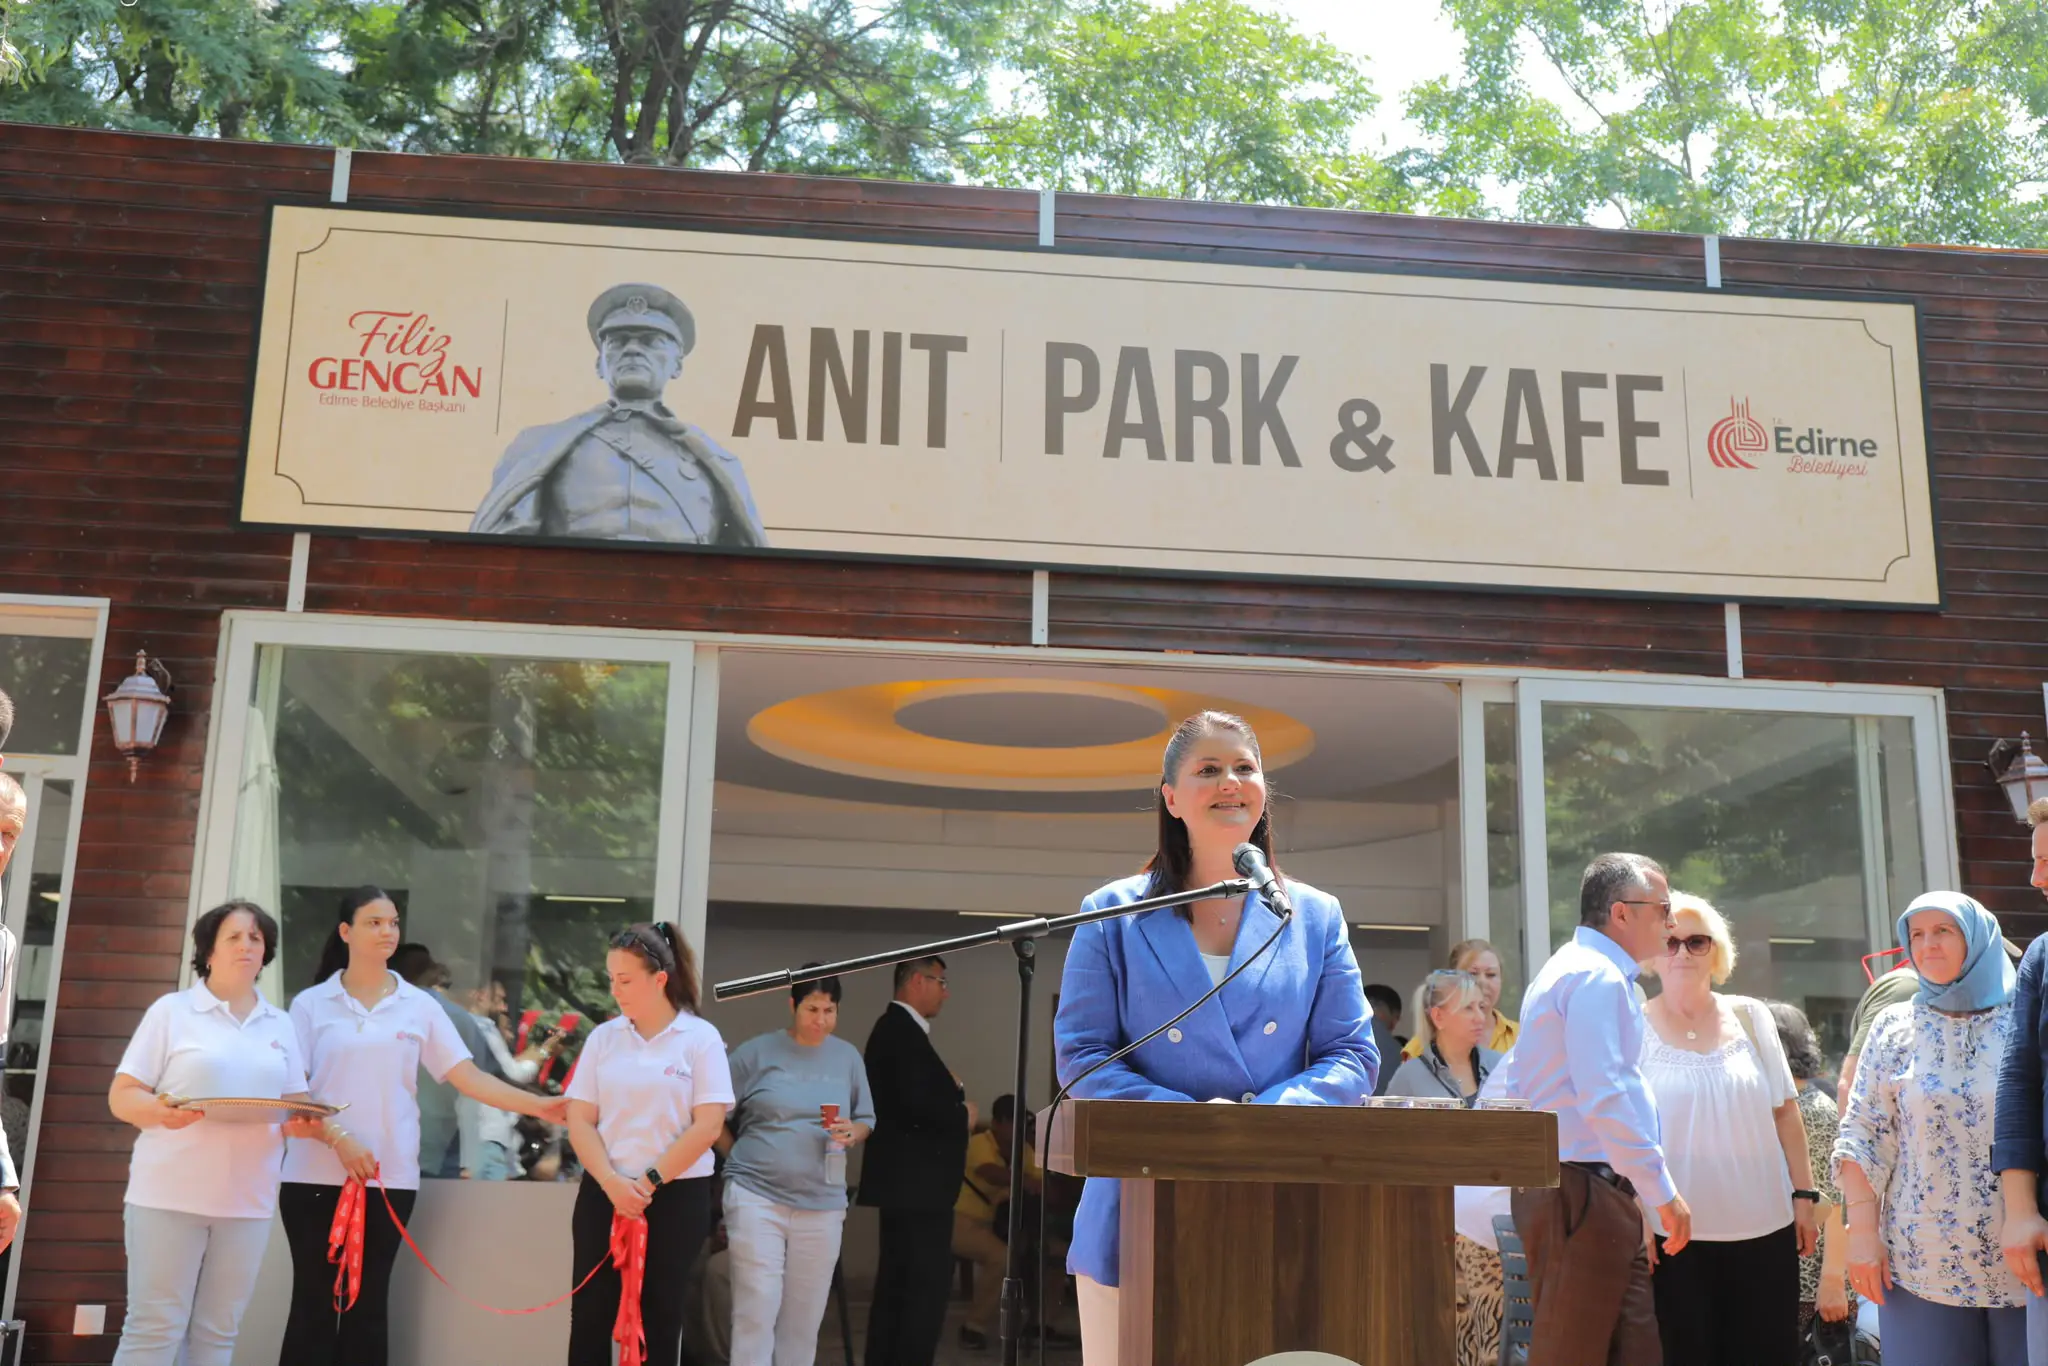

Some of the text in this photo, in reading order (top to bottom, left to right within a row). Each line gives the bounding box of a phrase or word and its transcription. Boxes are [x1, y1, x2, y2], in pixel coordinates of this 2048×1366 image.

[348, 310, 452, 378] Filiz
[308, 357, 482, 398] GENCAN
[318, 393, 466, 413] Edirne Belediye Başkanı
[731, 323, 1669, 486] ANIT PARK & KAFE
[1774, 426, 1878, 458] Edirne
[1787, 454, 1868, 480] Belediyesi
